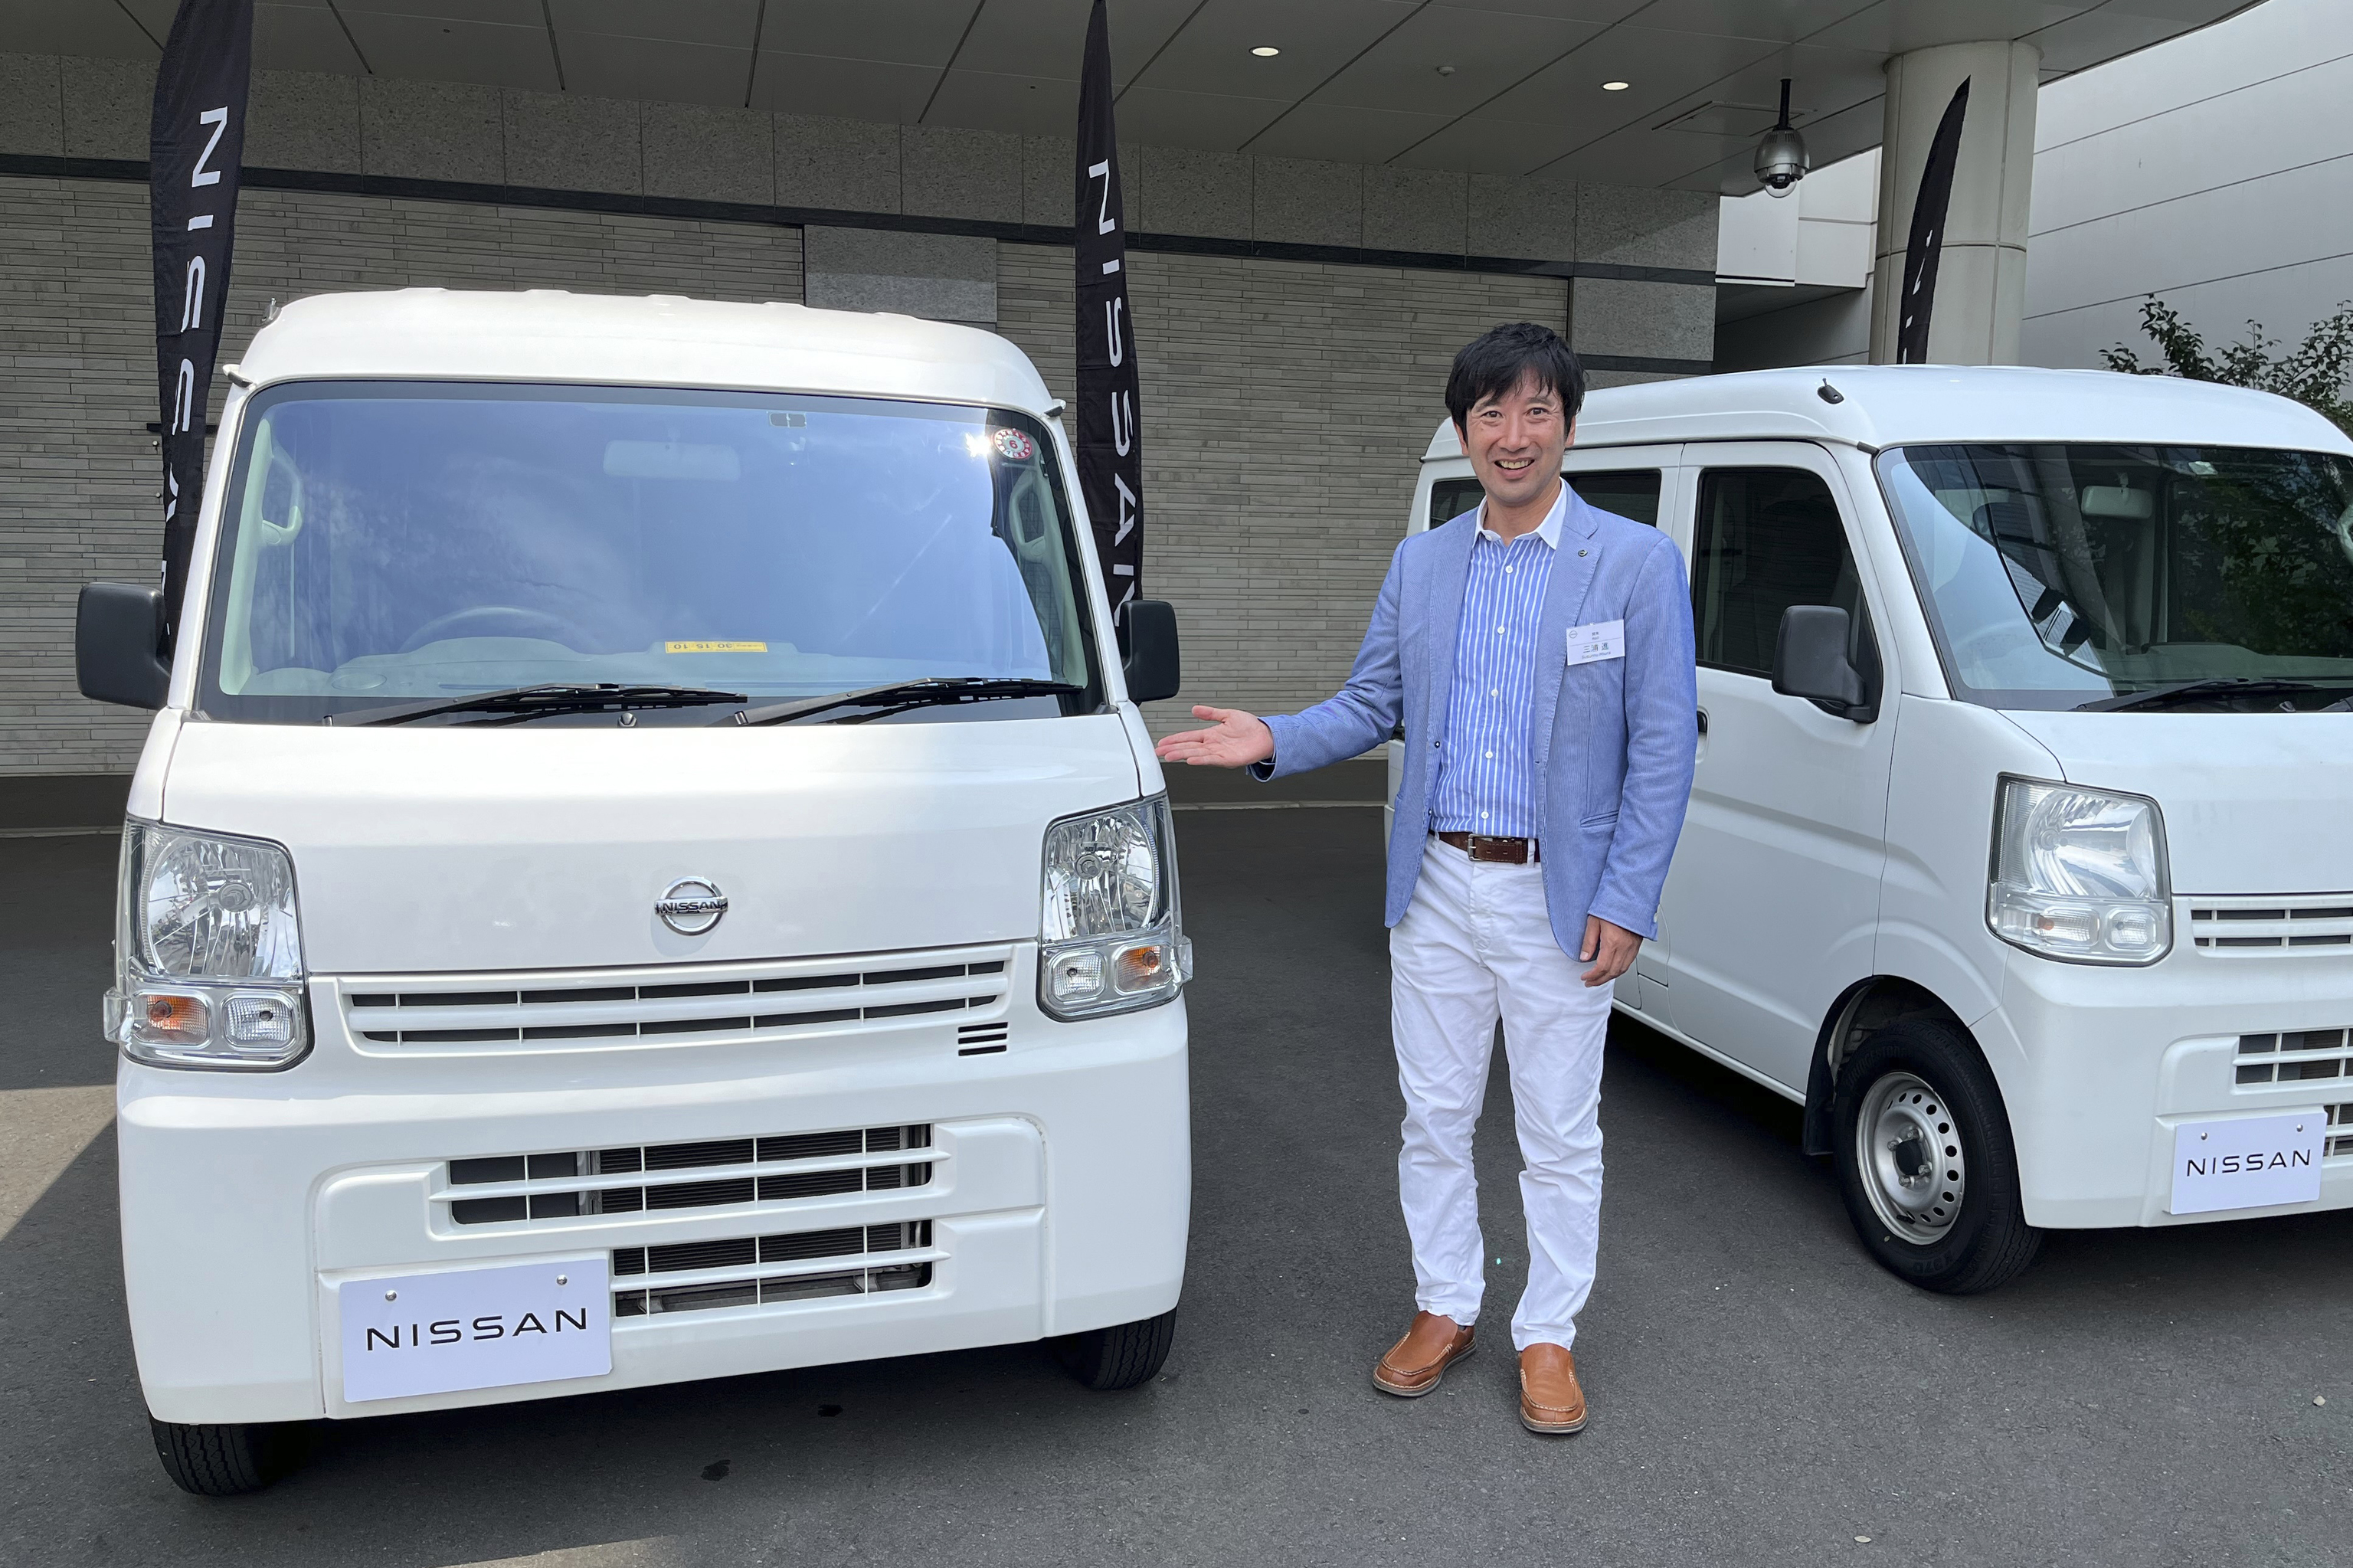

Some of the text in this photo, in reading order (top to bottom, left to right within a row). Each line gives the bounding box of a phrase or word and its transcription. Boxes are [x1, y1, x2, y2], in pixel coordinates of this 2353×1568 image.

[663, 901, 721, 912] NISSAN
[2186, 1149, 2311, 1177] NISSAN
[366, 1307, 587, 1352] NISSAN
